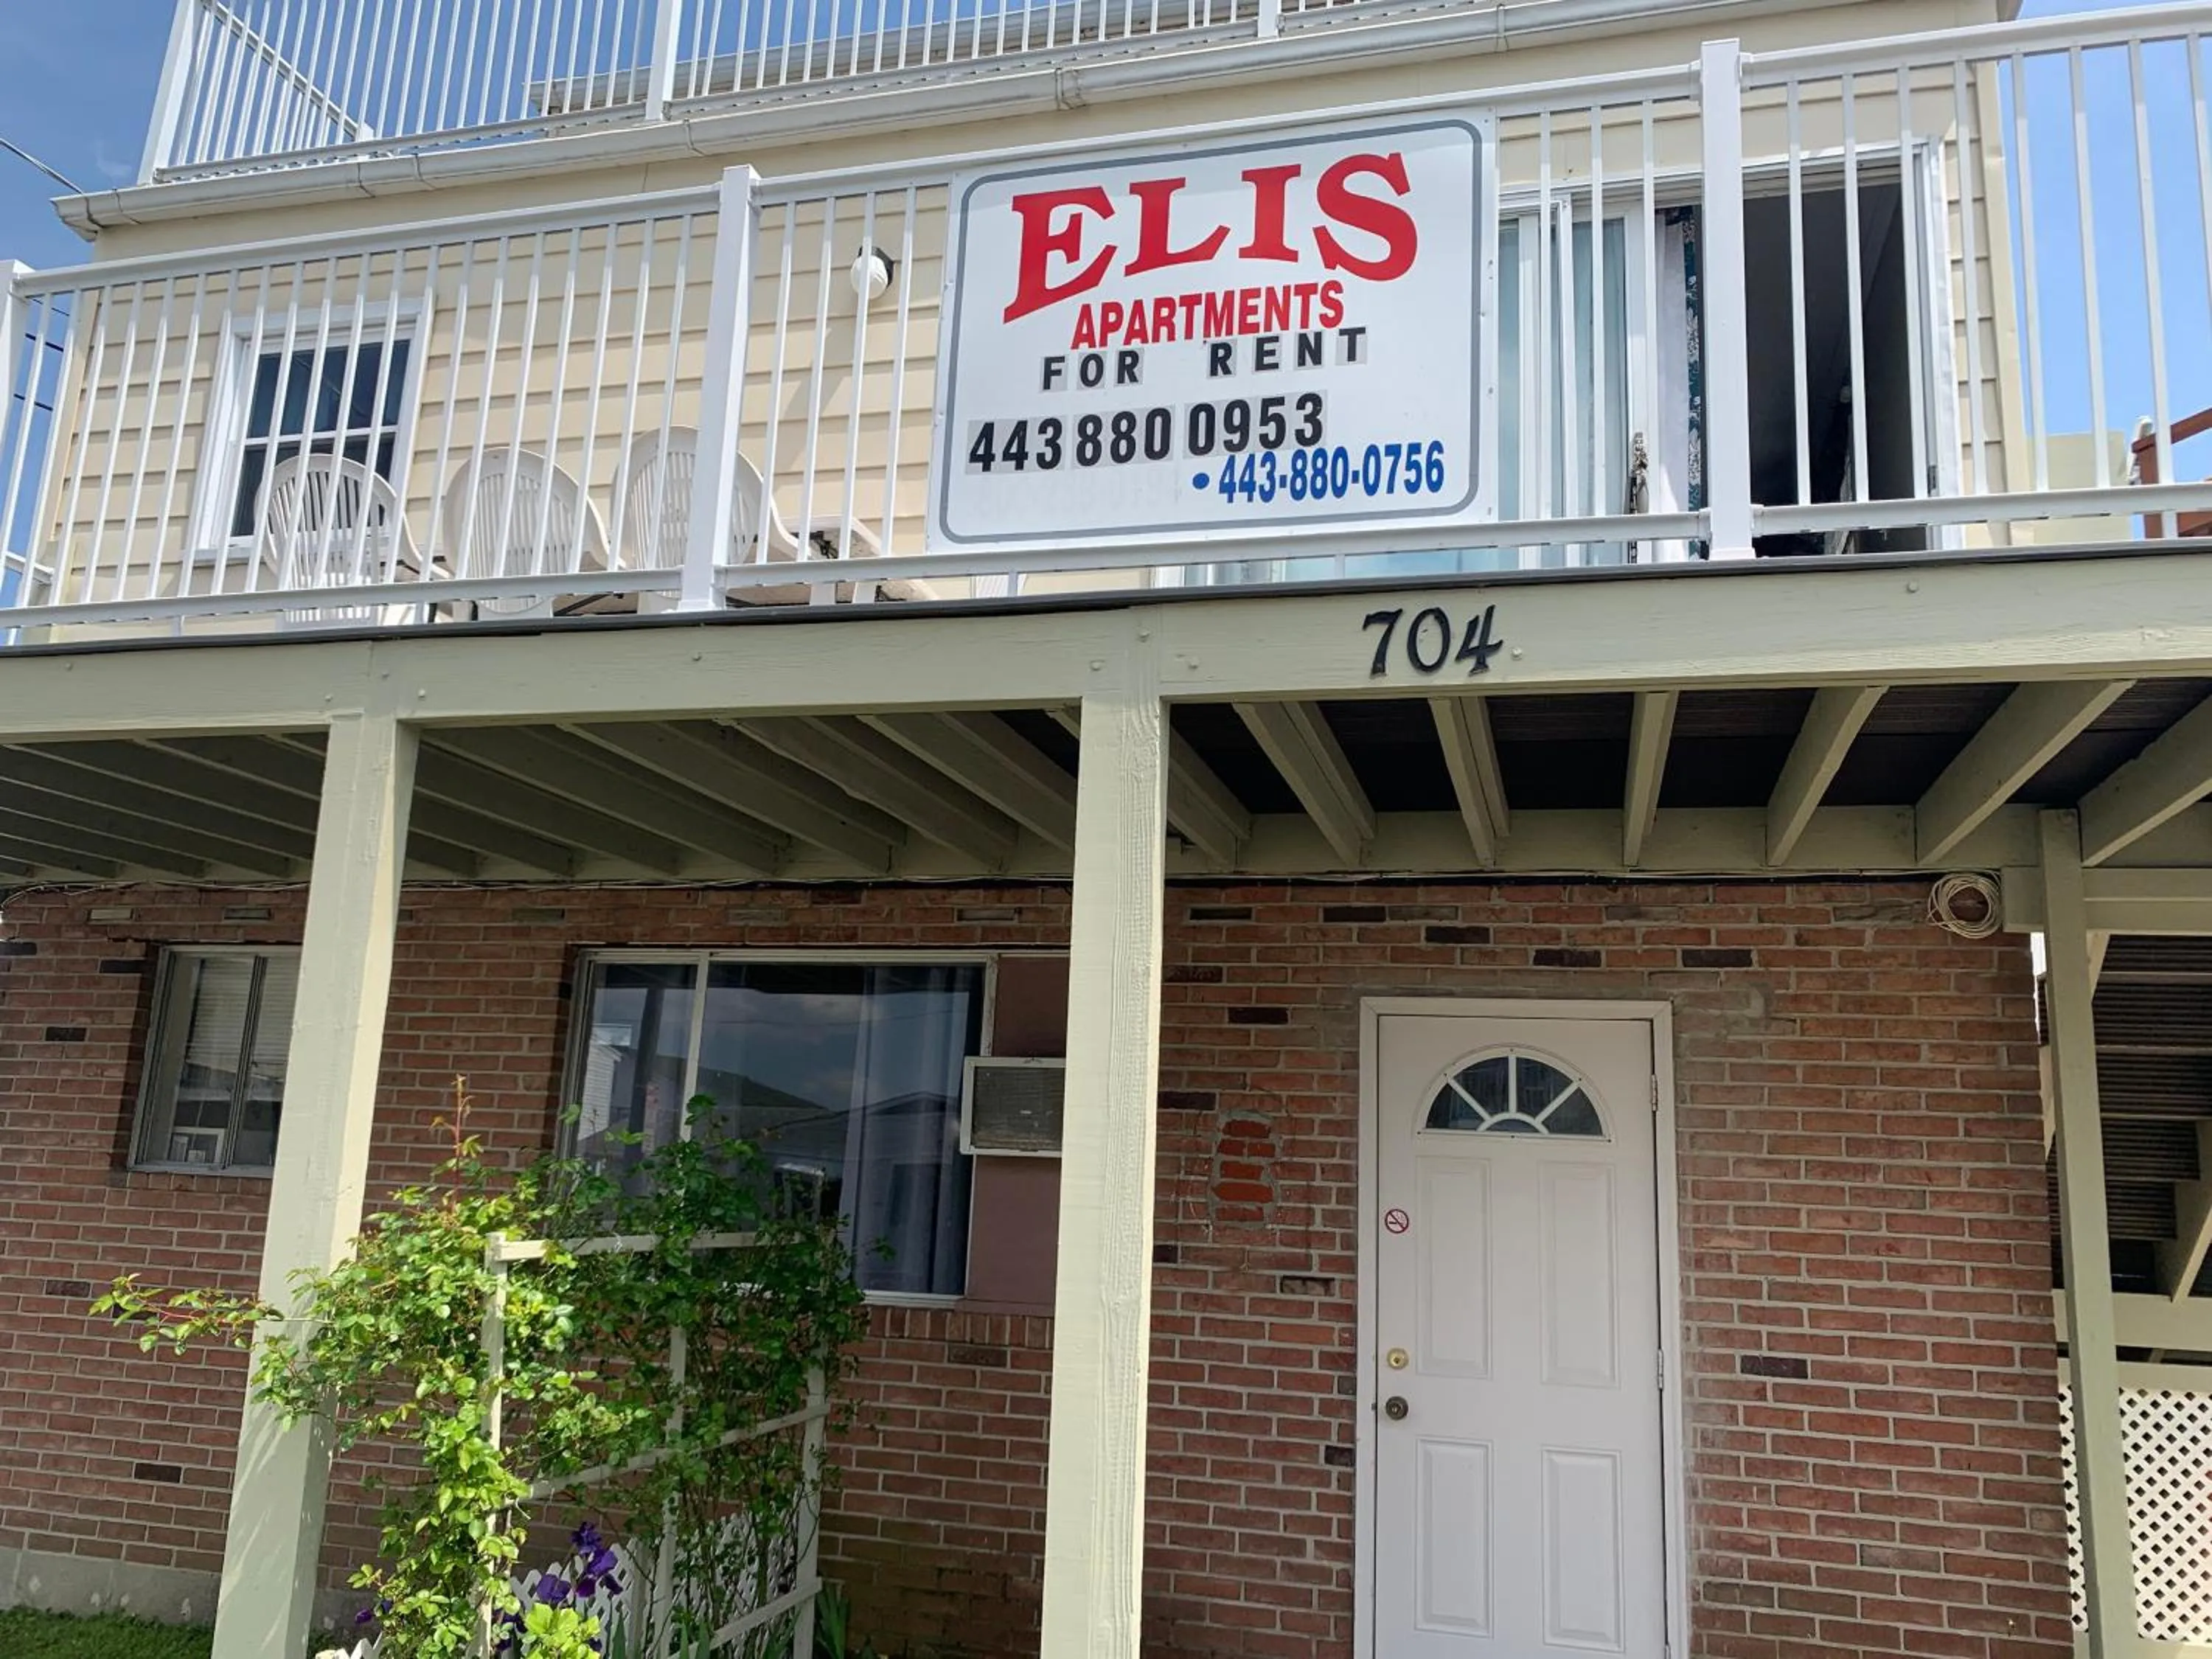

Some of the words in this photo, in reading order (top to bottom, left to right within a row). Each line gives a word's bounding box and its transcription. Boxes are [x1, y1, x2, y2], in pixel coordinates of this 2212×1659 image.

[1003, 152, 1418, 324] ELIS
[1071, 279, 1344, 350] APARTMENTS
[1043, 349, 1140, 390] FOR
[1210, 327, 1366, 377] RENT
[1219, 440, 1444, 503] 443-880-0756
[1362, 604, 1504, 677] 704
